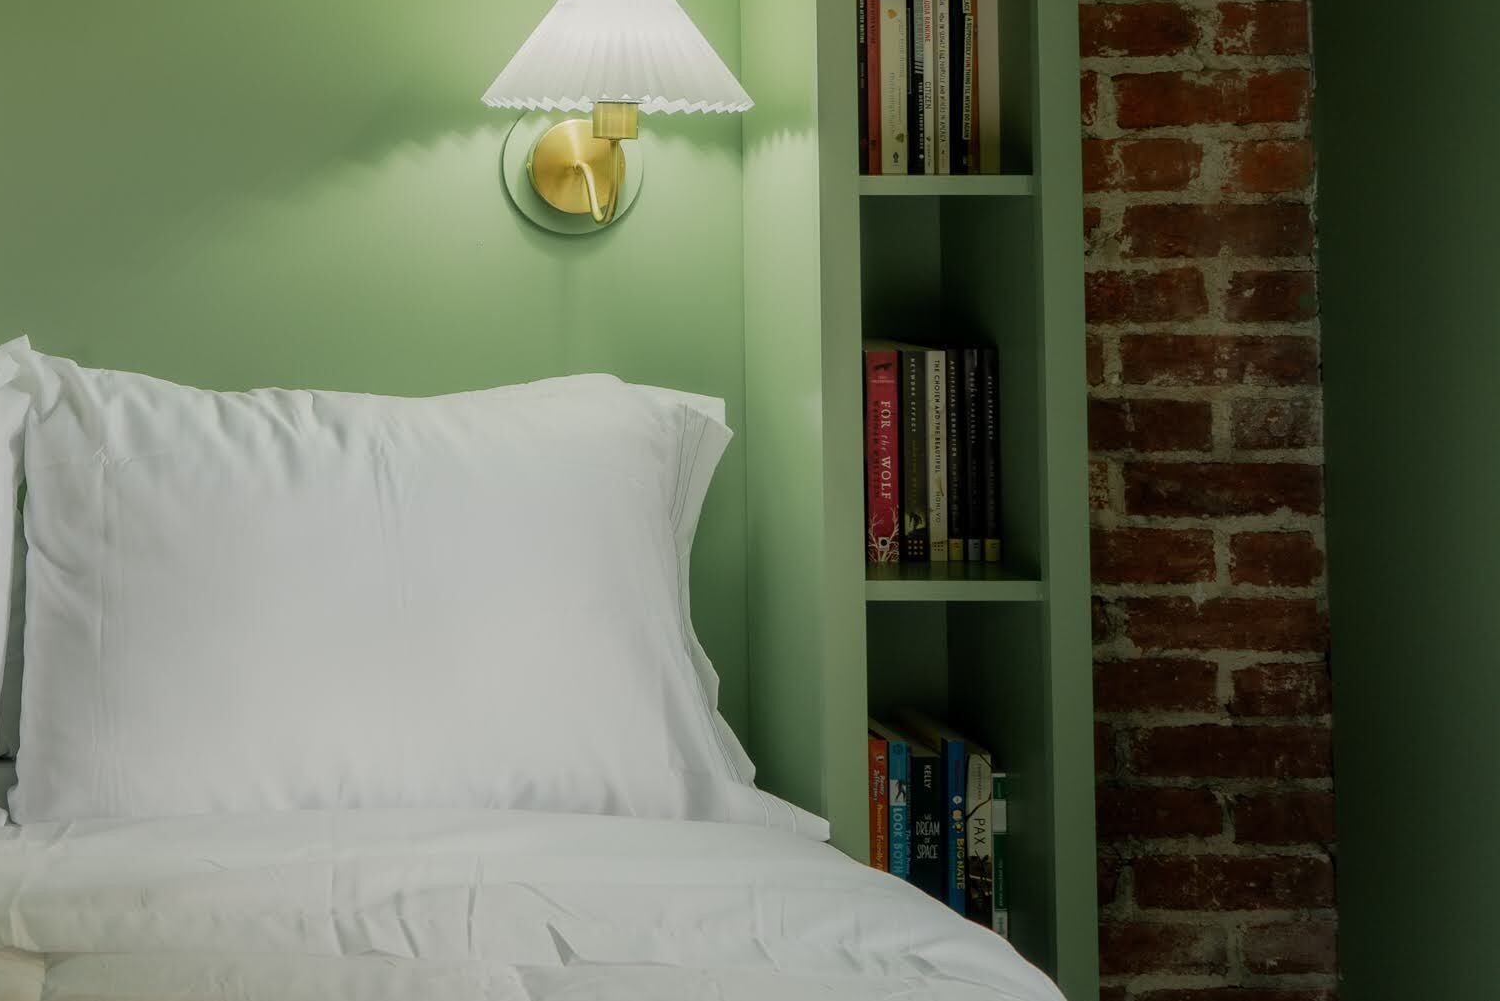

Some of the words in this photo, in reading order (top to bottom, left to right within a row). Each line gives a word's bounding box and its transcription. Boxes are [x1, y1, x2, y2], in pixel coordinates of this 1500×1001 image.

[881, 401, 891, 428] FOR
[881, 435, 890, 451] the
[881, 456, 891, 500] WOLF
[924, 765, 932, 788] KELLY
[916, 821, 940, 836] DREAM
[974, 818, 985, 844] PAX
[917, 844, 938, 859] SPACE
